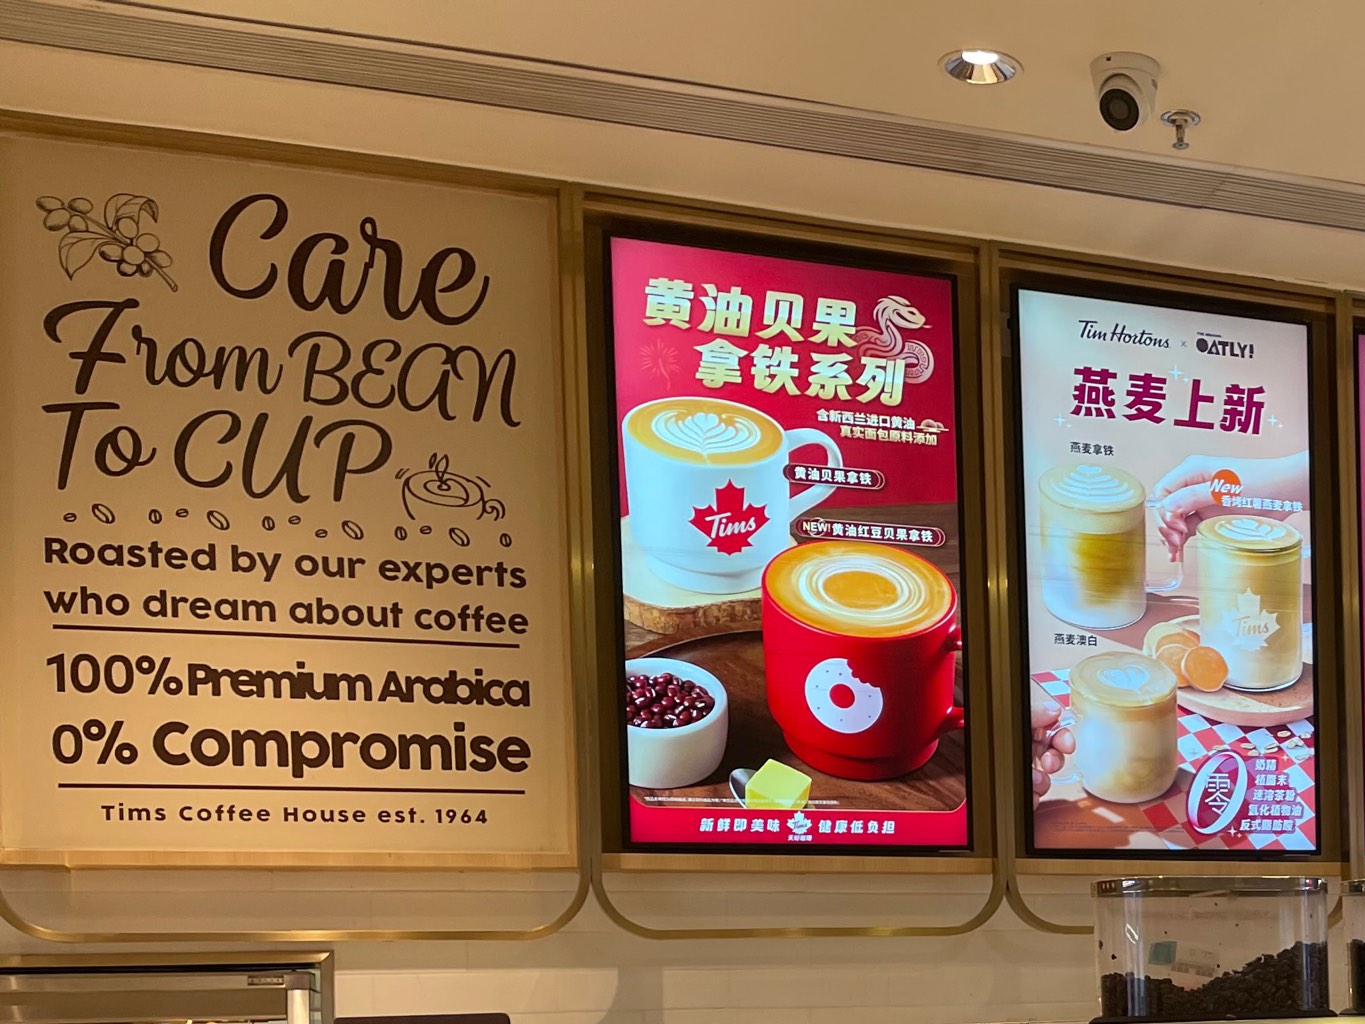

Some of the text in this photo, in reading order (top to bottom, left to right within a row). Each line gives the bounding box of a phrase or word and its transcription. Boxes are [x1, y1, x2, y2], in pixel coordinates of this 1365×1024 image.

[209, 194, 489, 326] Care
[643, 277, 858, 347] 黄油贝果
[1078, 319, 1107, 341] Tim
[1110, 323, 1170, 349] Hortons
[1196, 338, 1254, 359] OATLY!
[43, 298, 521, 427] From BEAN
[693, 338, 906, 407] 拿铁系列
[816, 408, 916, 430] 含新西兰进口黄油
[1070, 366, 1266, 435] 燕麦上新
[42, 401, 393, 503] To CUP
[839, 424, 938, 446] 真实面包原料添加
[1070, 441, 1114, 456] 燕麦拿铁
[794, 466, 872, 486] 黄油贝果拿铁
[1210, 479, 1244, 494] New
[705, 511, 756, 540] Tims
[802, 520, 933, 543] NEW! 黄油红豆贝果拿铁
[44, 537, 527, 589] Roasted by our experts
[44, 587, 529, 635] who dream about coffee
[1233, 616, 1269, 636] Tims
[1054, 633, 1098, 647] 燕麦澳白
[46, 653, 530, 707] 100% Premium Arabica
[52, 719, 531, 777] 0% Compromise
[101, 803, 488, 824] Tims Coffee House est. 1964
[1205, 773, 1231, 815] 零
[699, 818, 780, 832] 新鲜即美味
